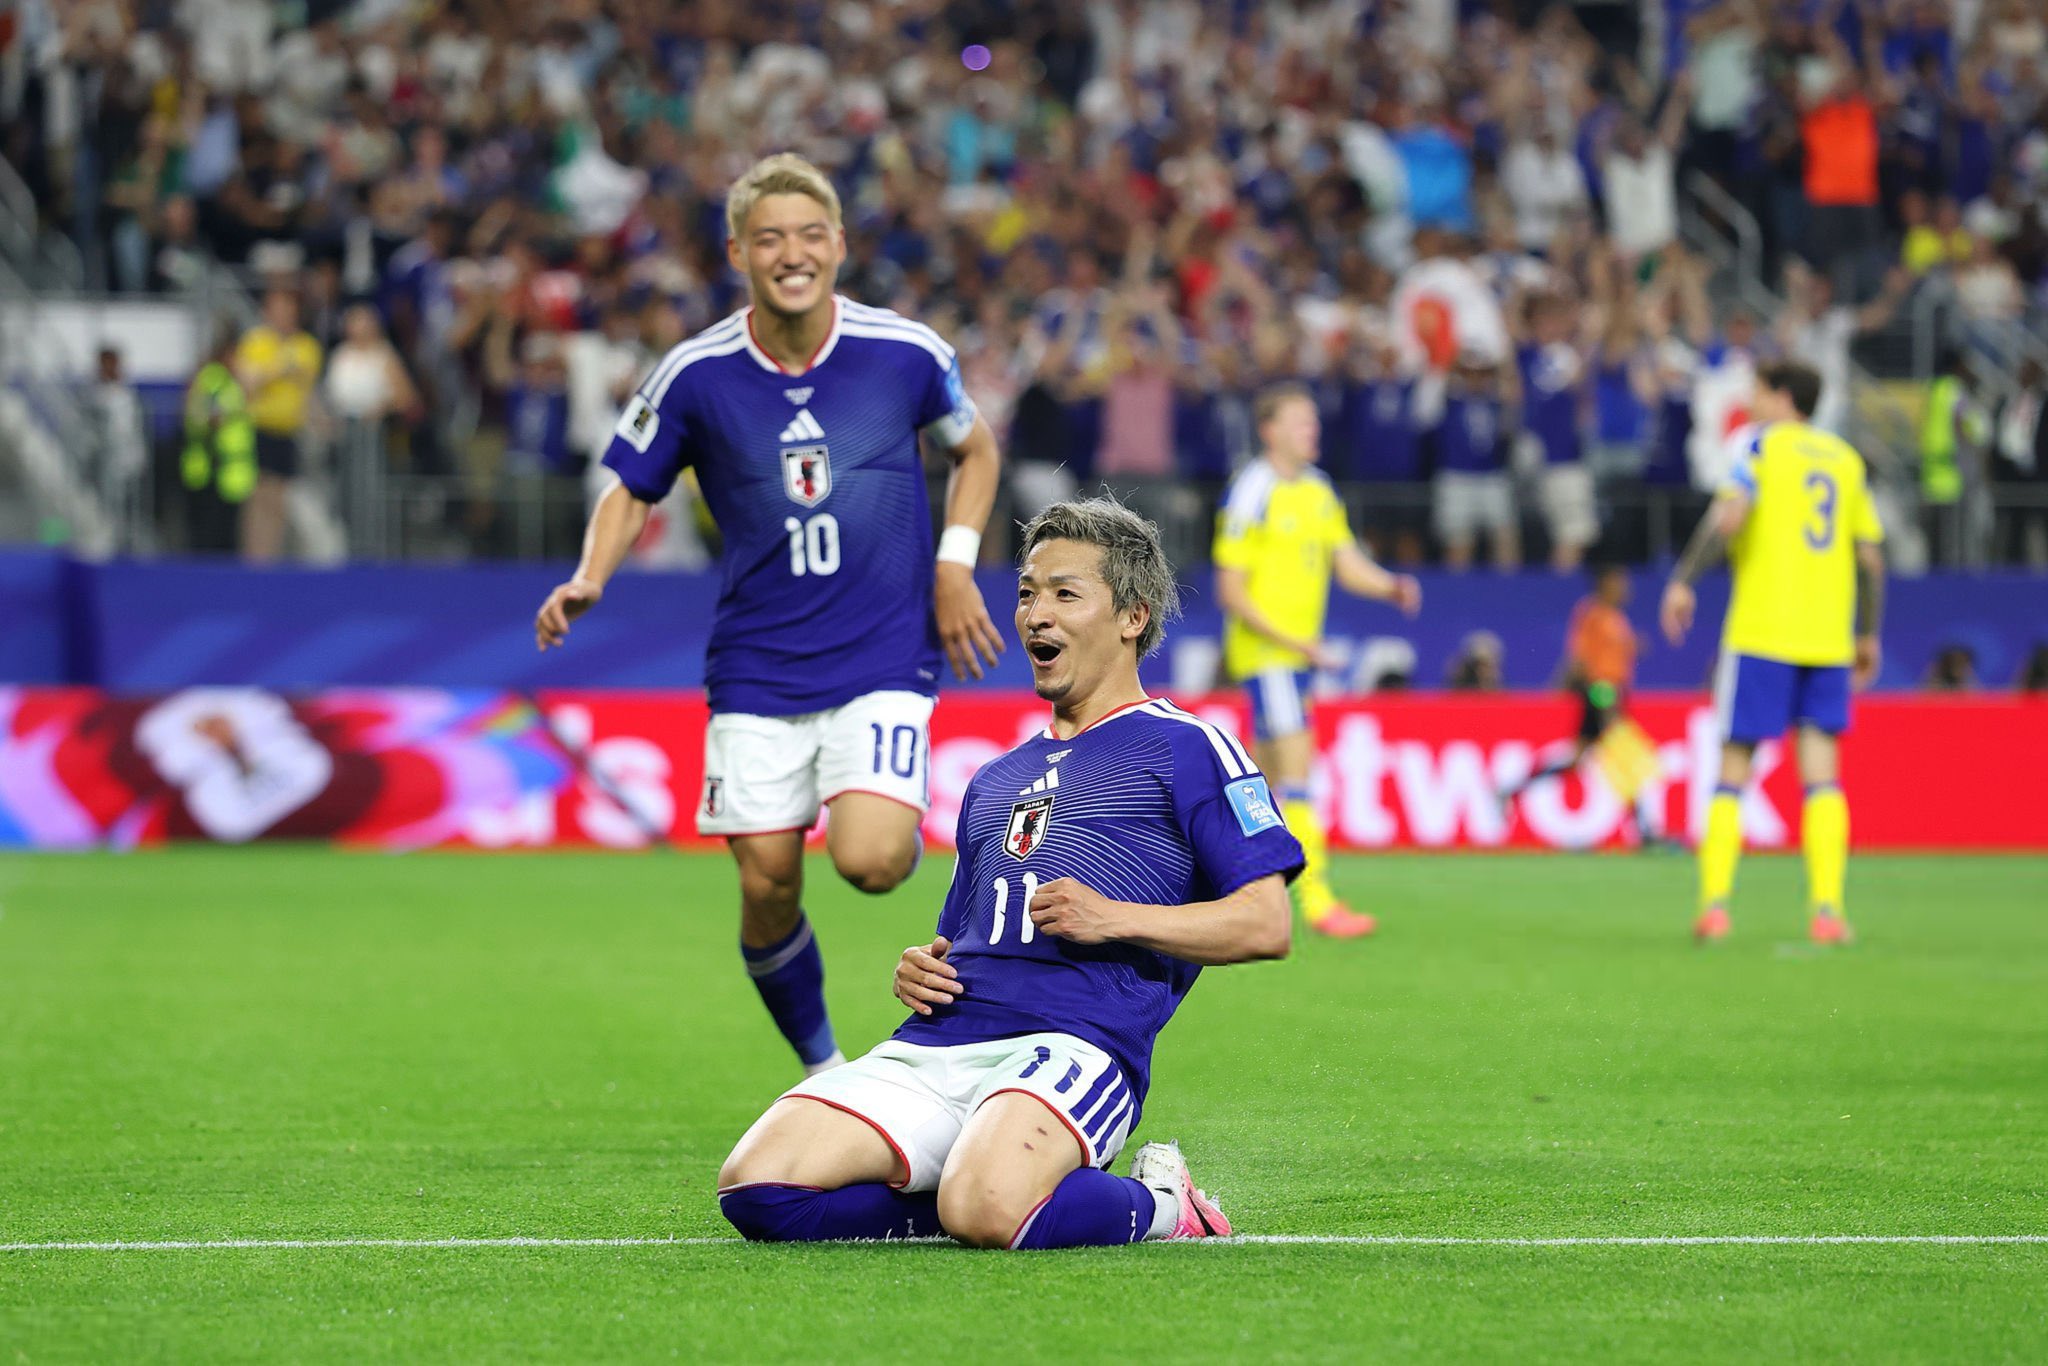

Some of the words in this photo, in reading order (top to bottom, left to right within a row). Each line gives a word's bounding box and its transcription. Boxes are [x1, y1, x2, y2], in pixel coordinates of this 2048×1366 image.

[1803, 471, 1836, 553] 3
[784, 512, 841, 577] 10
[871, 723, 916, 778] 10
[1023, 800, 1045, 810] JAPAN
[1015, 839, 1033, 851] JFA
[989, 871, 1039, 945] 11
